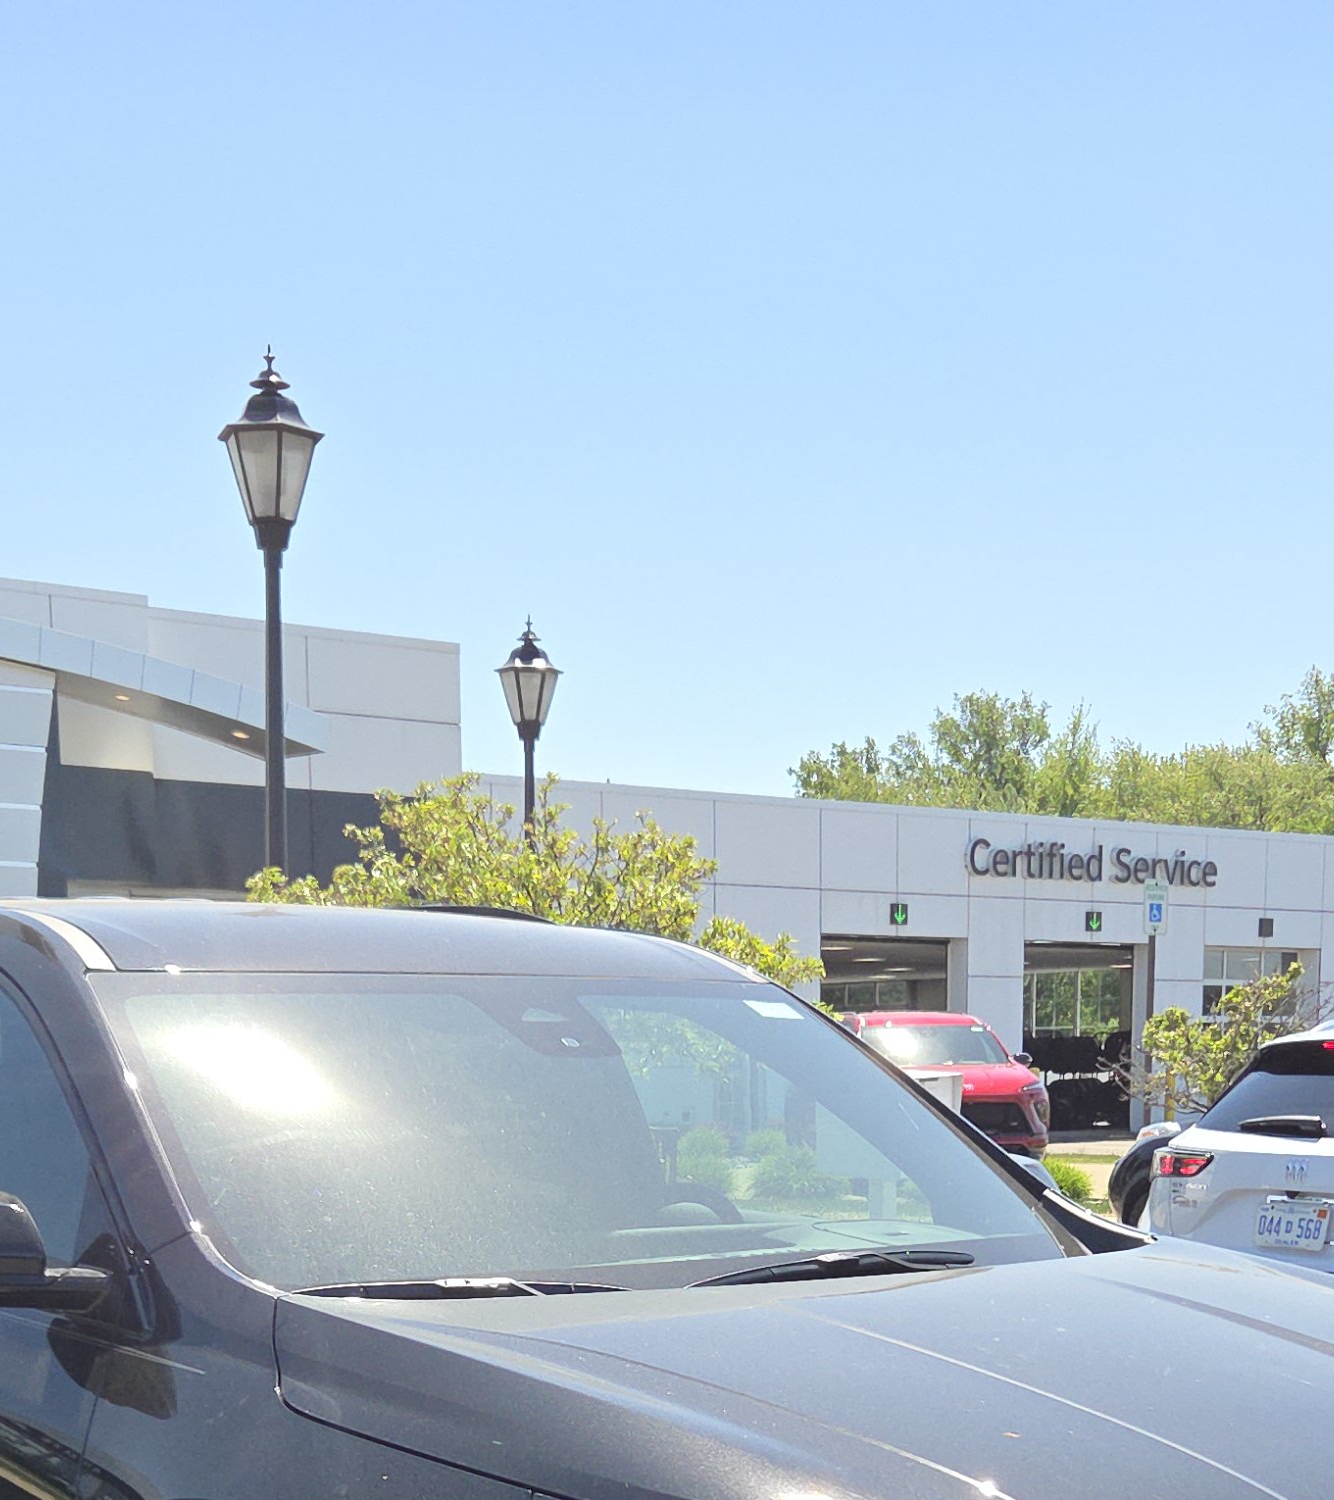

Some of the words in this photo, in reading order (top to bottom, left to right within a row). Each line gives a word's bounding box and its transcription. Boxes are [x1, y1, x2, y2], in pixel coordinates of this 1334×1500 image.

[969, 837, 1104, 882] Certified
[1115, 847, 1218, 887] Service
[1258, 1215, 1282, 1236] 044
[1296, 1217, 1322, 1240] 568
